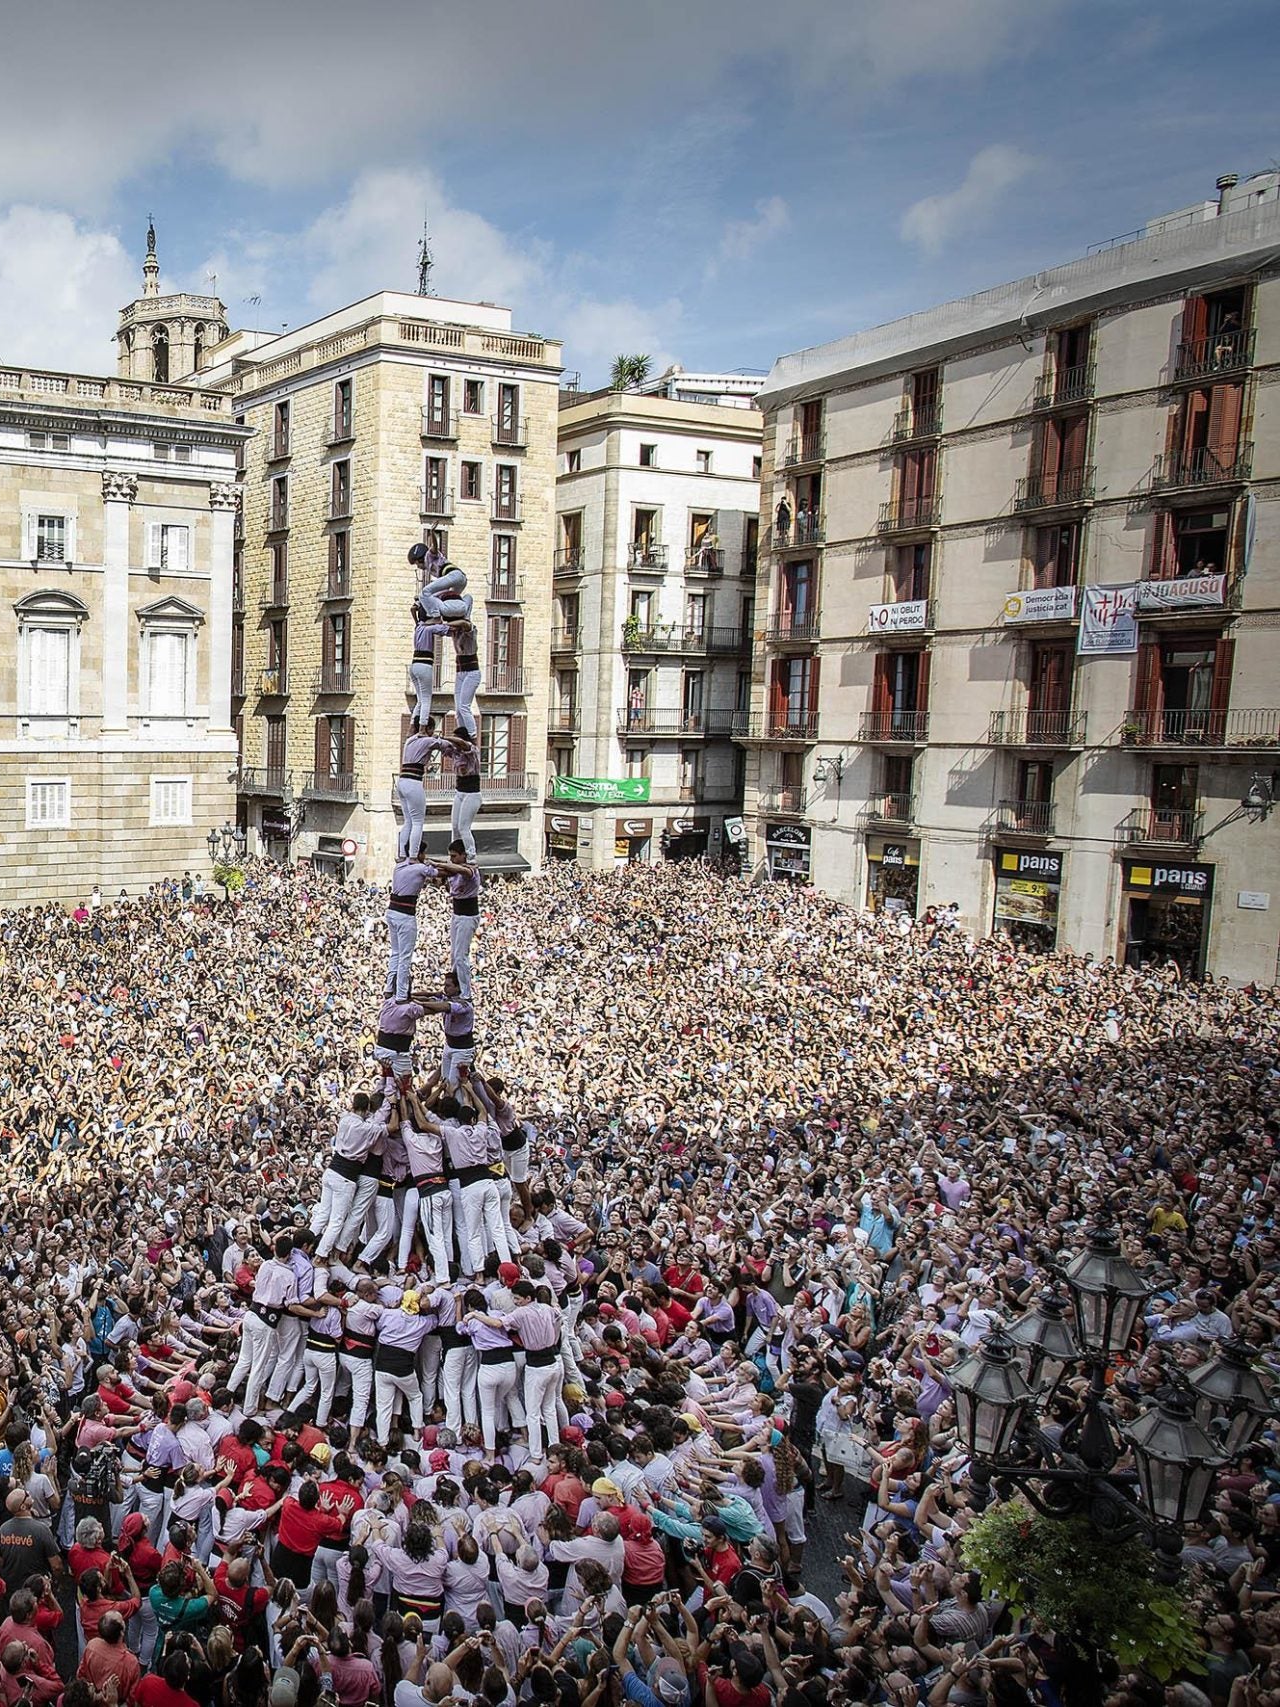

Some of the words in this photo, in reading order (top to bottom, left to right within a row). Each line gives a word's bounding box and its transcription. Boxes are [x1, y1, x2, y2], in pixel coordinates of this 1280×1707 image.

[900, 606, 920, 614] OBLIT
[576, 790, 600, 799] SALIDA
[772, 826, 806, 842] BARCELONA
[883, 855, 903, 865] pans
[1020, 855, 1060, 871] pans
[1154, 868, 1208, 886] pans
[0, 1533, 33, 1547] betevé
